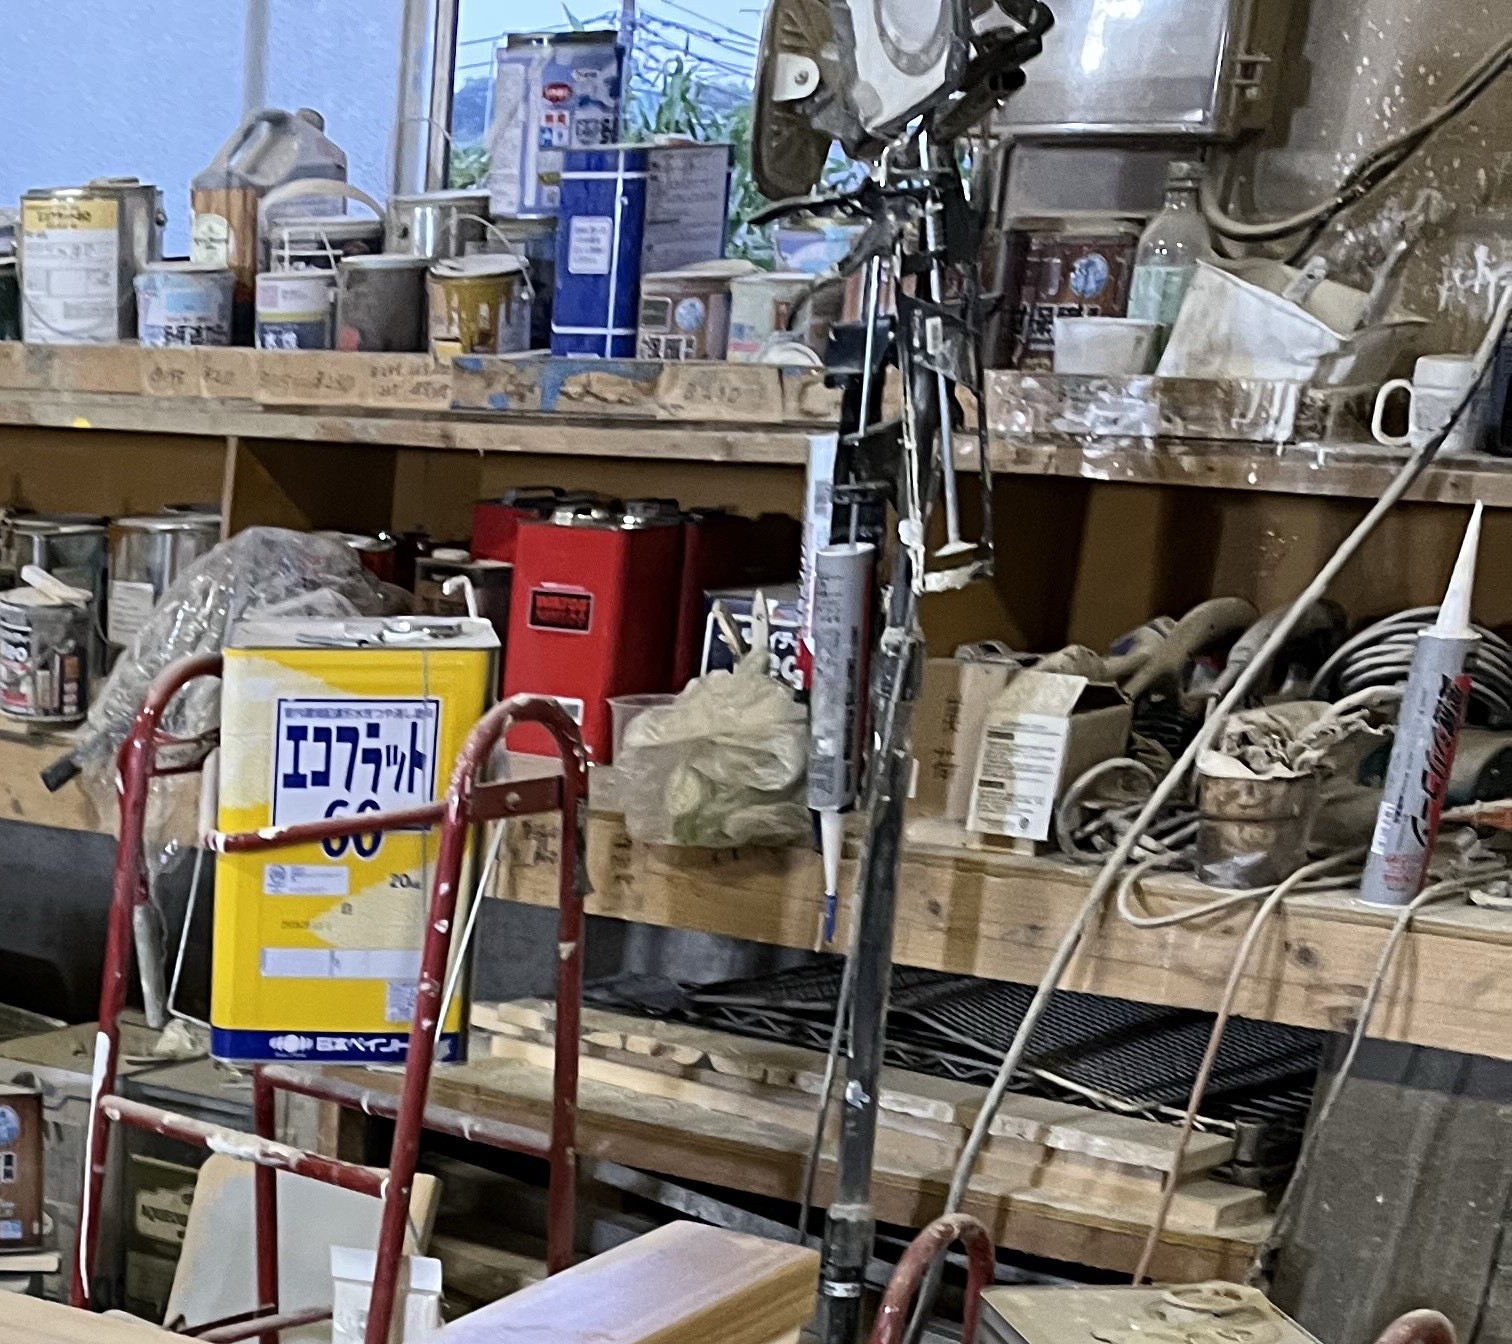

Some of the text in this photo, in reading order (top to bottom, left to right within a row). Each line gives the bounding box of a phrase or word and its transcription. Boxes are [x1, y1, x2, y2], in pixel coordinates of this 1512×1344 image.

[282, 720, 427, 794] エコフラット
[320, 798, 384, 858] 60
